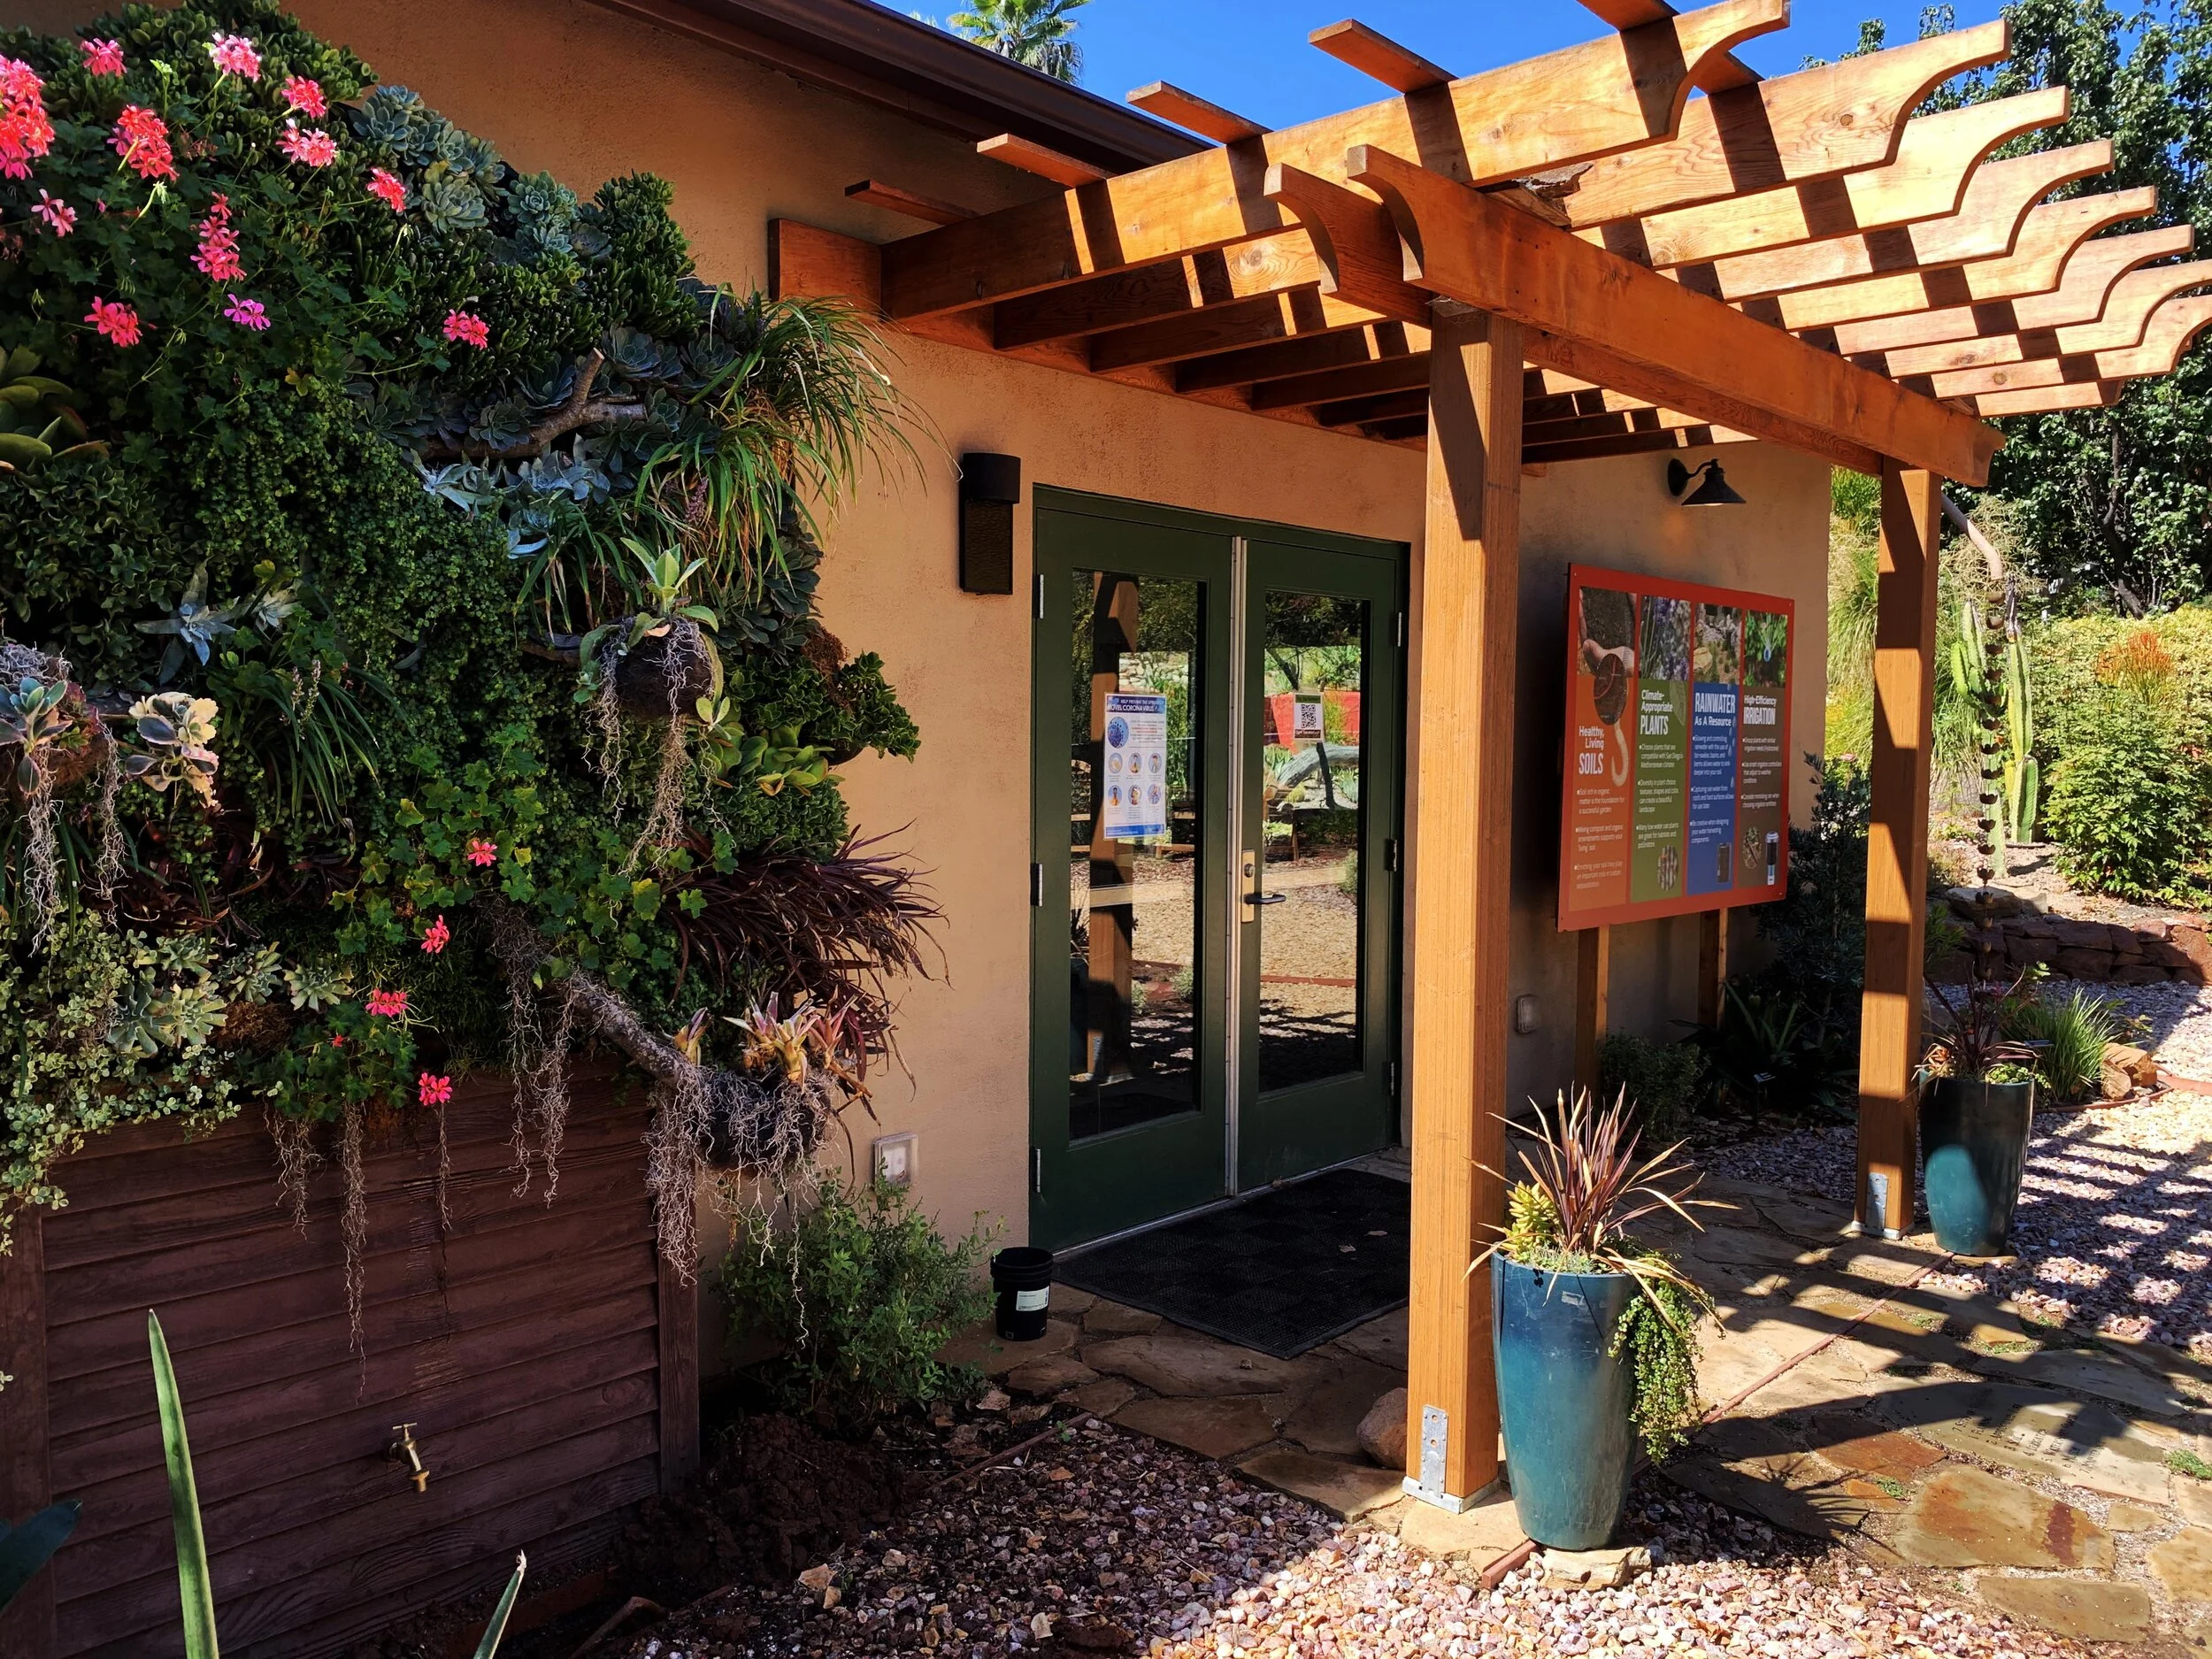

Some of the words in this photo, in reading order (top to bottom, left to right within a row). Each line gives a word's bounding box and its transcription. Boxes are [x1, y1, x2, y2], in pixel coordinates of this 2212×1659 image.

[1641, 689, 1664, 701] Climate-
[1744, 695, 1777, 707] High-Efficiency
[1641, 701, 1673, 713] Appropriate
[1694, 692, 1736, 713] RAINWATER
[1694, 716, 1701, 726] As
[1702, 716, 1707, 726] A
[1709, 716, 1732, 726] Resource
[1743, 707, 1776, 725] IRRIGATION
[1640, 715, 1669, 734] PLANTS
[1579, 726, 1605, 739] Healthy,
[1586, 738, 1604, 750] Living
[1578, 753, 1603, 774] SOILS
